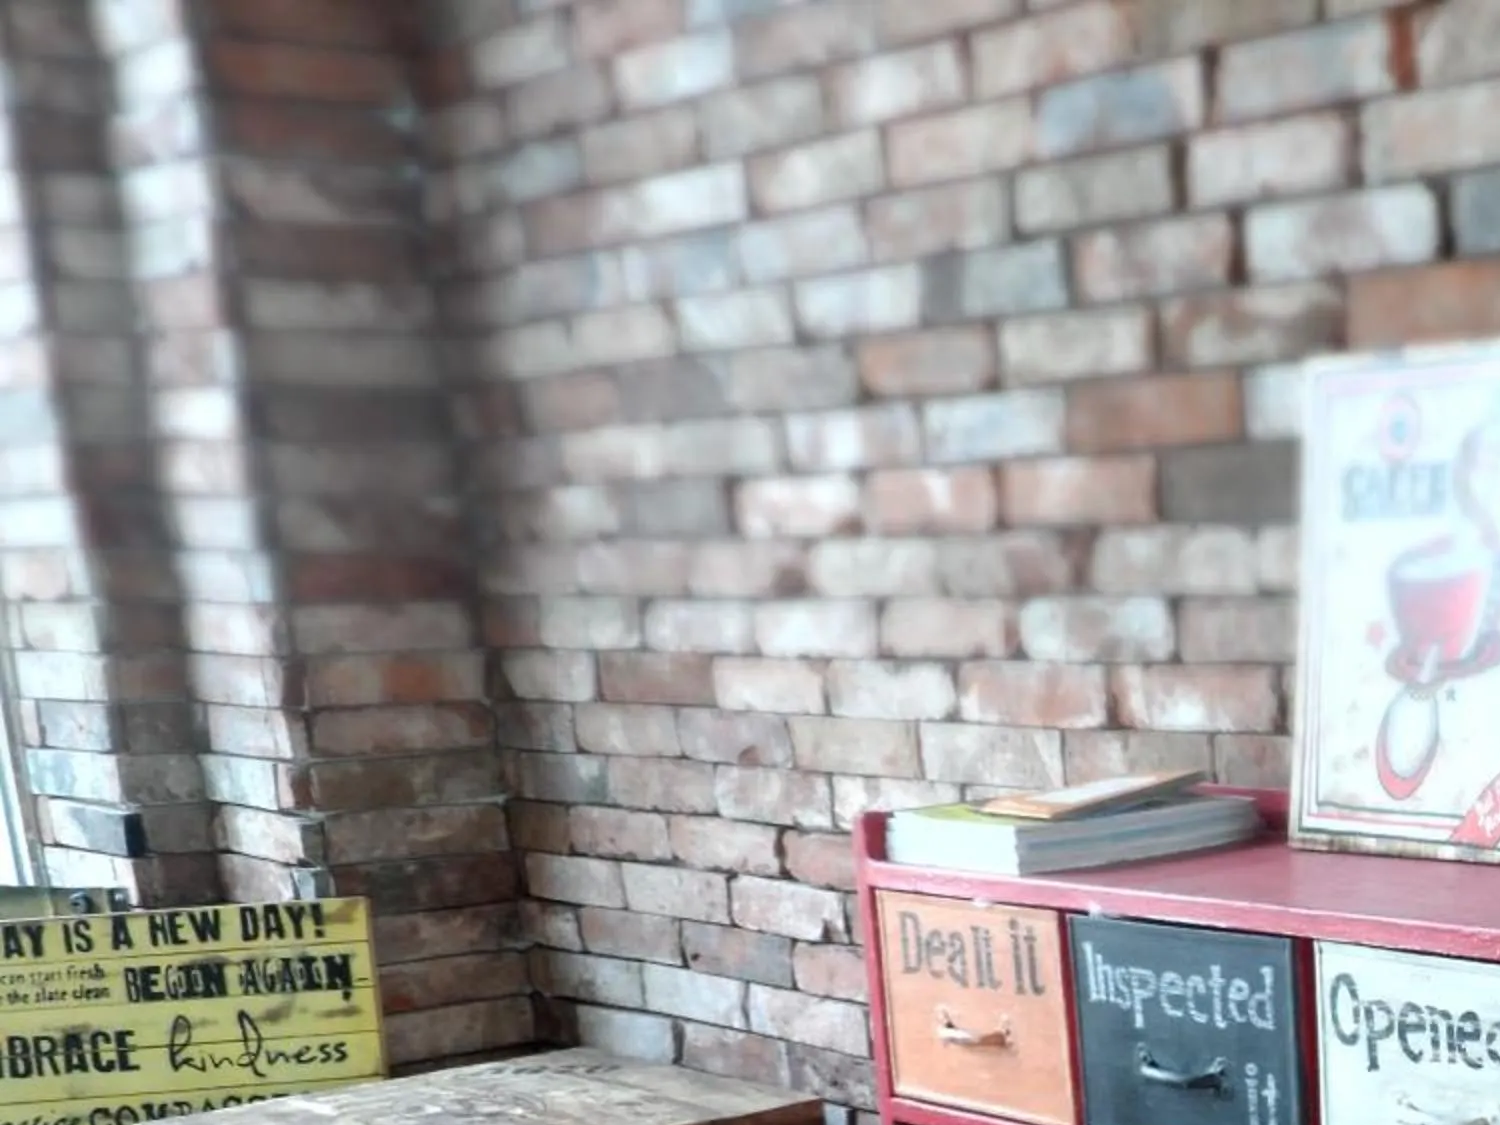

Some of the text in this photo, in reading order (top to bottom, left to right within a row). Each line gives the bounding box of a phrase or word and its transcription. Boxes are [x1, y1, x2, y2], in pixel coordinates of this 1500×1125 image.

[64, 919, 94, 953] IS
[112, 914, 134, 950] A
[149, 907, 222, 946] NEW
[241, 902, 326, 940] DAY!
[1010, 917, 1046, 997] it
[125, 960, 228, 1004] BEGIN
[1082, 941, 1277, 1031] Inspected
[0, 1010, 349, 1079] BRACE kindness
